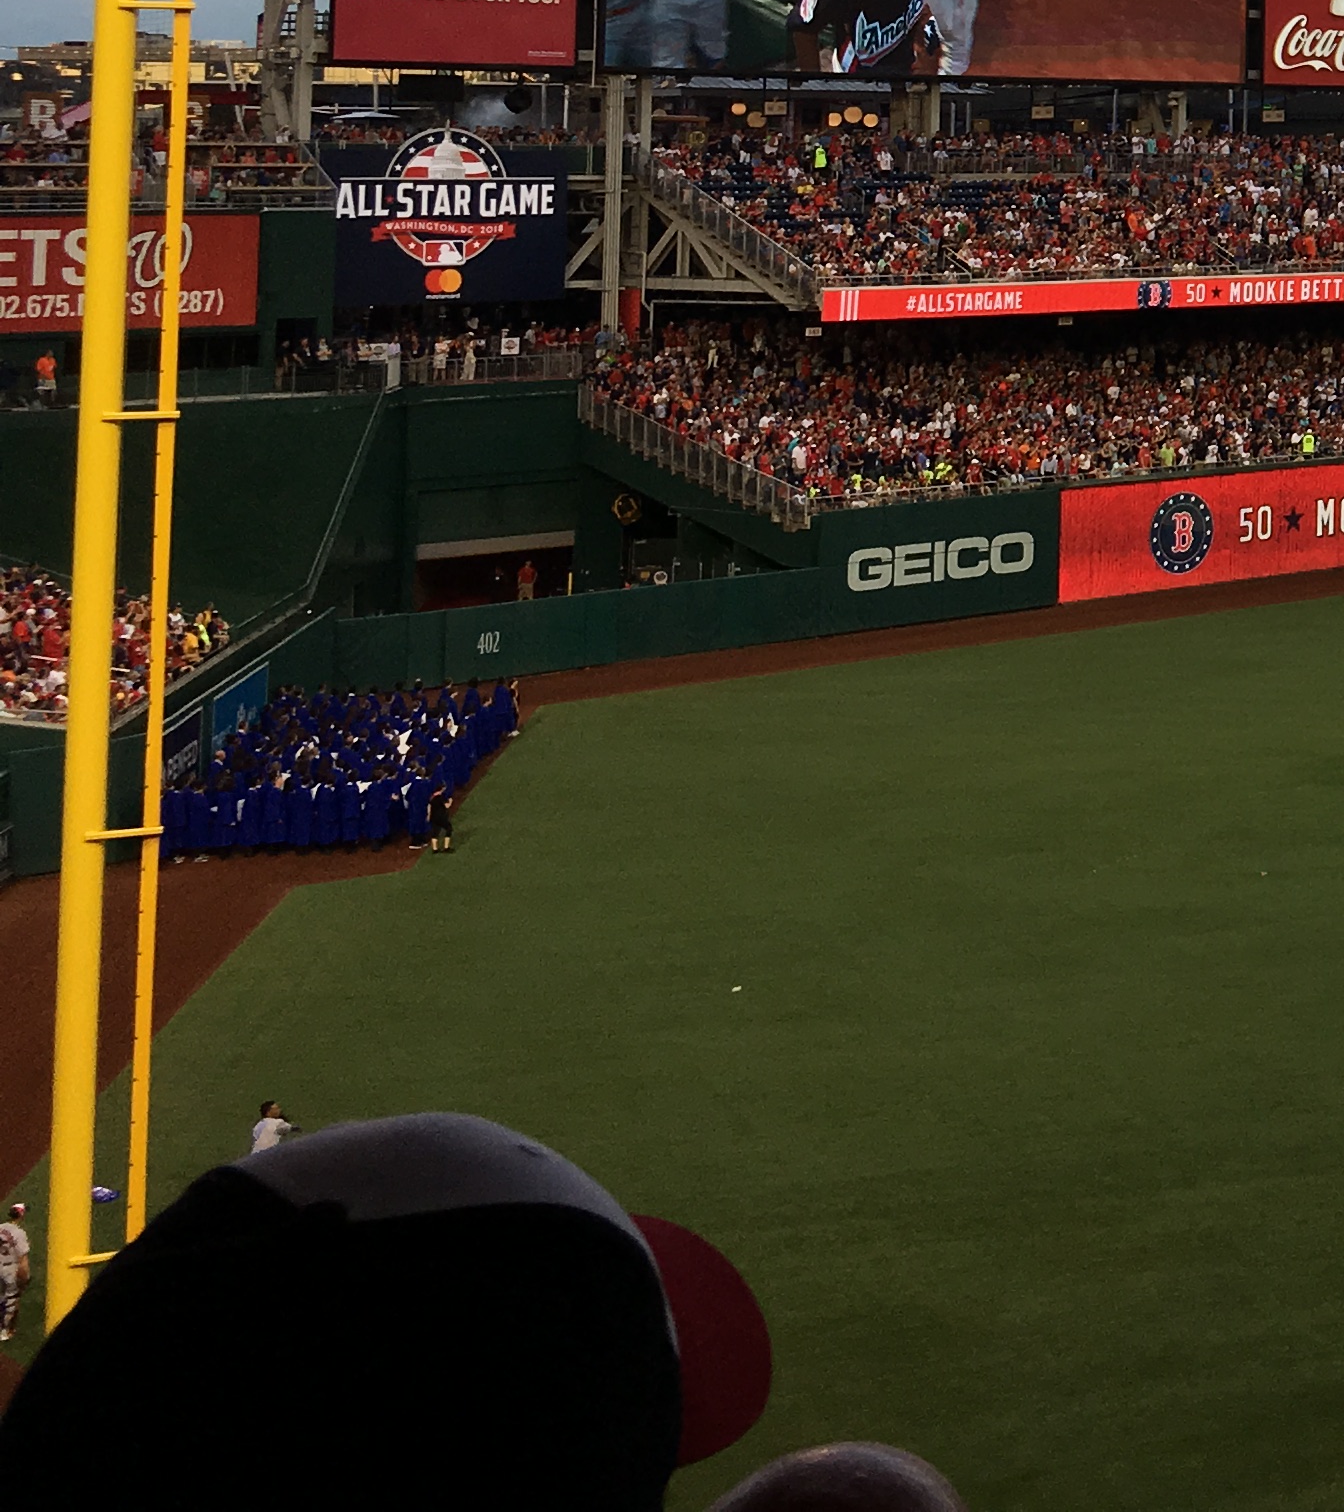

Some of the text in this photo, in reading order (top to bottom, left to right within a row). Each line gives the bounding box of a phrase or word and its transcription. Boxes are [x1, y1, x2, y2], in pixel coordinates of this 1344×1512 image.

[335, 182, 555, 219] ALL STAR GAME
[460, 225, 474, 234] DC
[480, 224, 504, 234] 2018
[154, 287, 224, 317] (287)
[906, 291, 1023, 313] #ALLSTARGAME
[1186, 283, 1206, 303] 50
[1229, 280, 1295, 304] MOOKIE
[1239, 506, 1272, 543] 50
[847, 531, 1034, 592] GEICO
[477, 631, 500, 655] 402
